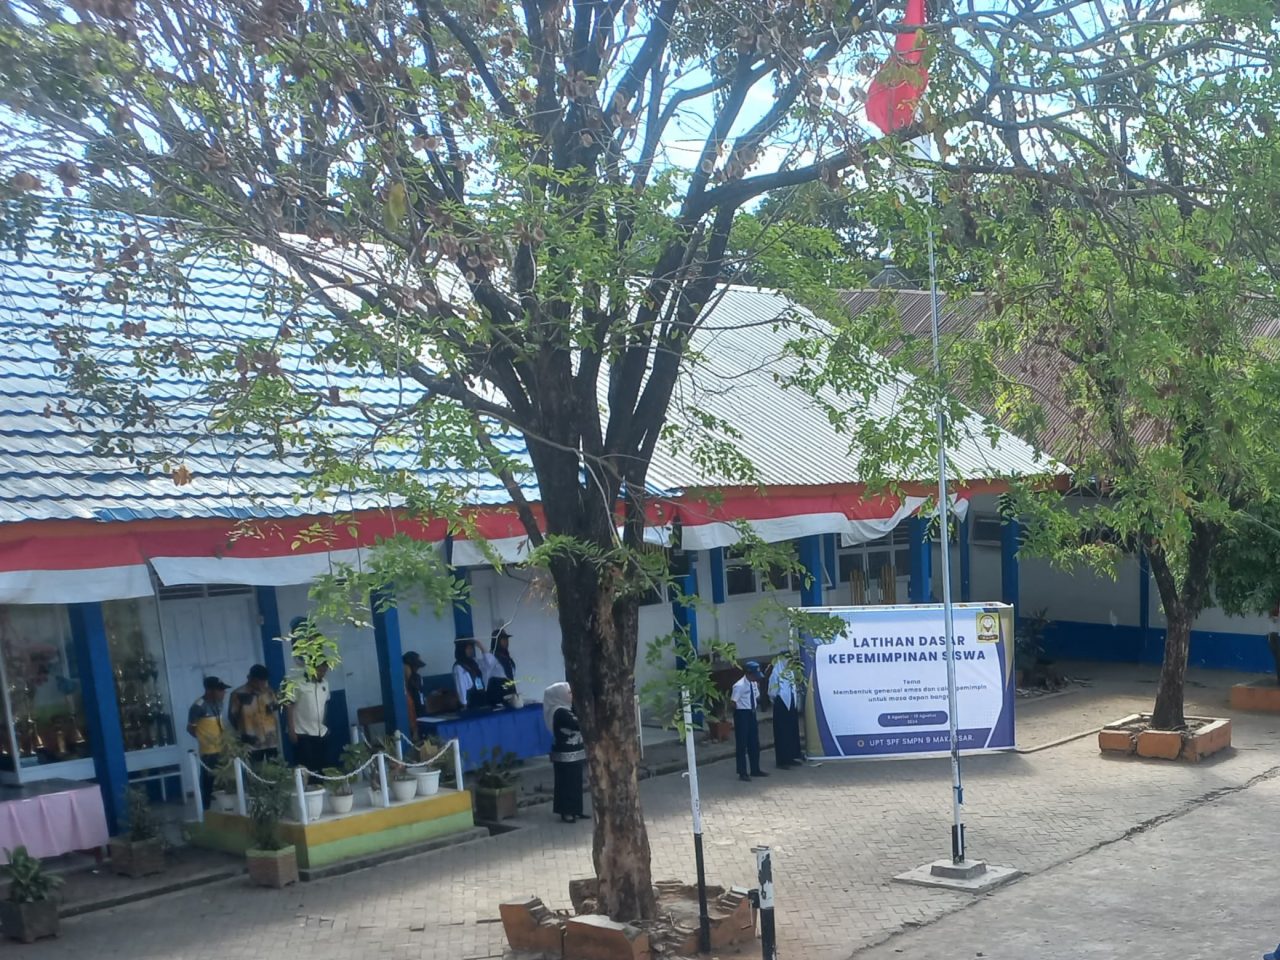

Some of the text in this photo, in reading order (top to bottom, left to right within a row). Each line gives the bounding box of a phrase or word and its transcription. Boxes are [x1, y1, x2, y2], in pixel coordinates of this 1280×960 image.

[853, 637, 915, 648] LATIHAN
[828, 652, 938, 664] KEPEMIMPINAN
[886, 738, 900, 746] SPF
[902, 737, 924, 745] SMPN
